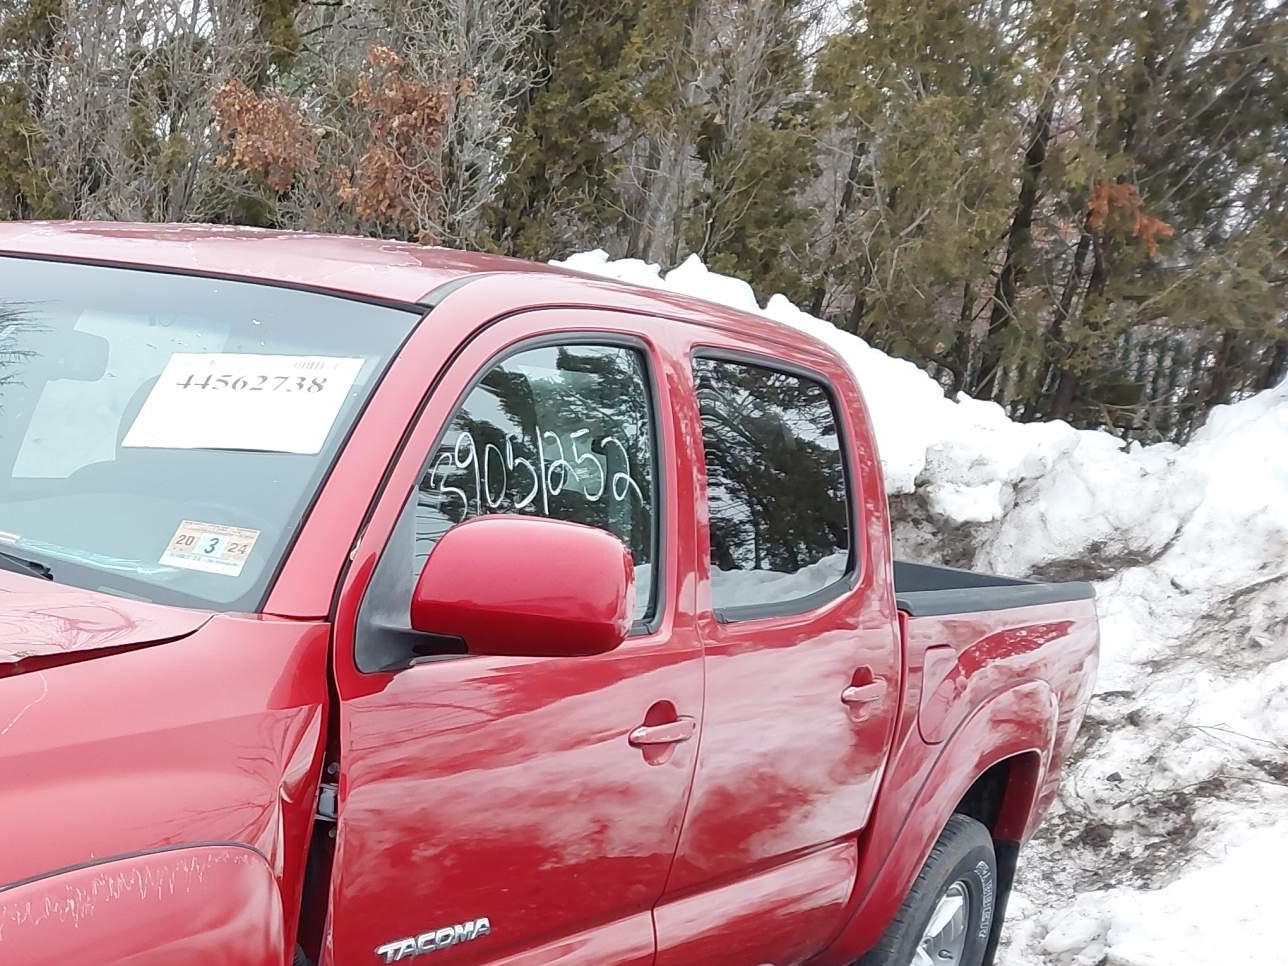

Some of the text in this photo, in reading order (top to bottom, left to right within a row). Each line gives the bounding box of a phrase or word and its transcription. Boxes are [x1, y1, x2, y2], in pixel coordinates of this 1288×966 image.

[176, 373, 328, 393] 44562738
[176, 534, 249, 555] 20 3 24
[376, 917, 491, 963] TACOMA
